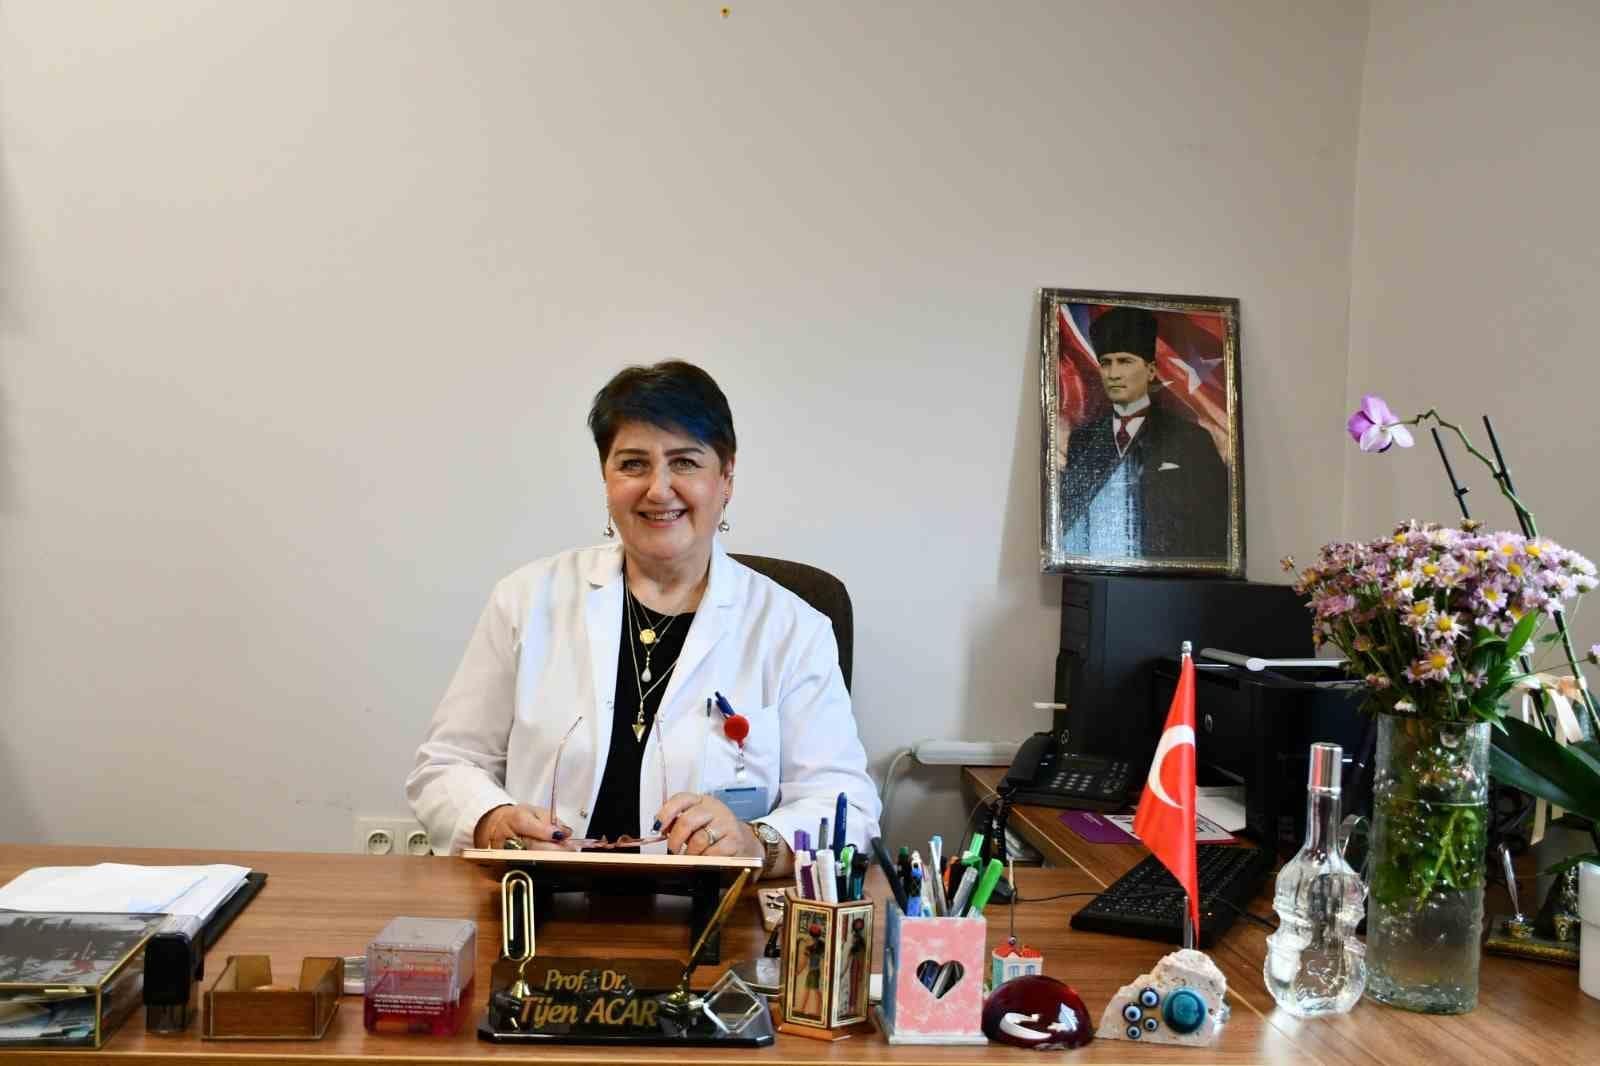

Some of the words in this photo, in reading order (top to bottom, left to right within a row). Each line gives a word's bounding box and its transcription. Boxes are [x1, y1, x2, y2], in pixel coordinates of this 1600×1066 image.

[544, 969, 590, 992] Prof.
[600, 970, 626, 991] Dr.
[519, 996, 578, 1029] Tijen
[584, 997, 657, 1025] ACAR
